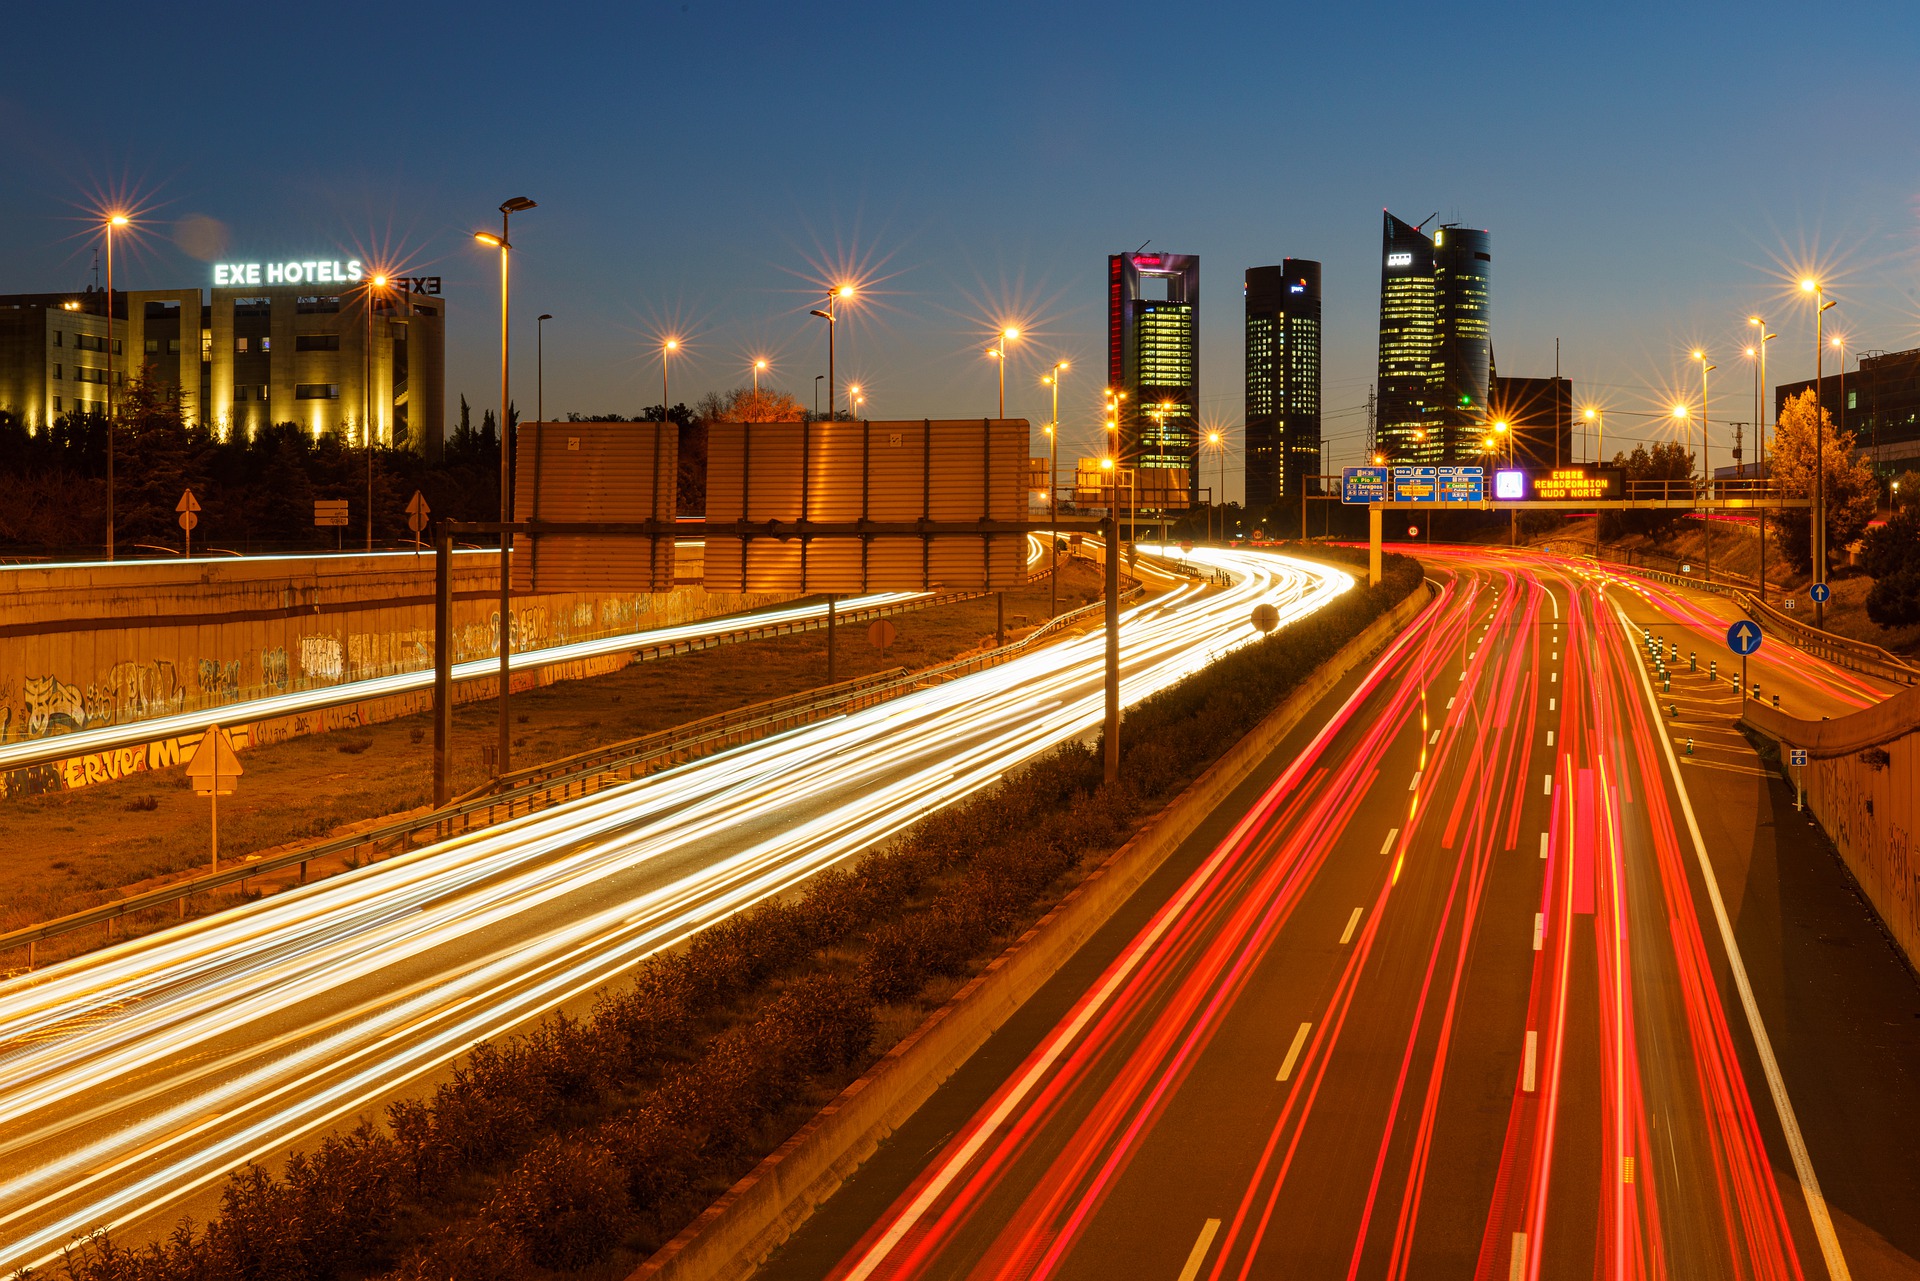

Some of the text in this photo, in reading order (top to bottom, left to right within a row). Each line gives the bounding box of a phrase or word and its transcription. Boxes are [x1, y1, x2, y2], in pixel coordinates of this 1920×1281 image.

[214, 260, 362, 284] EXE HOTELS
[1540, 488, 1602, 497] NUDO NORTE
[1796, 757, 1802, 765] 6
